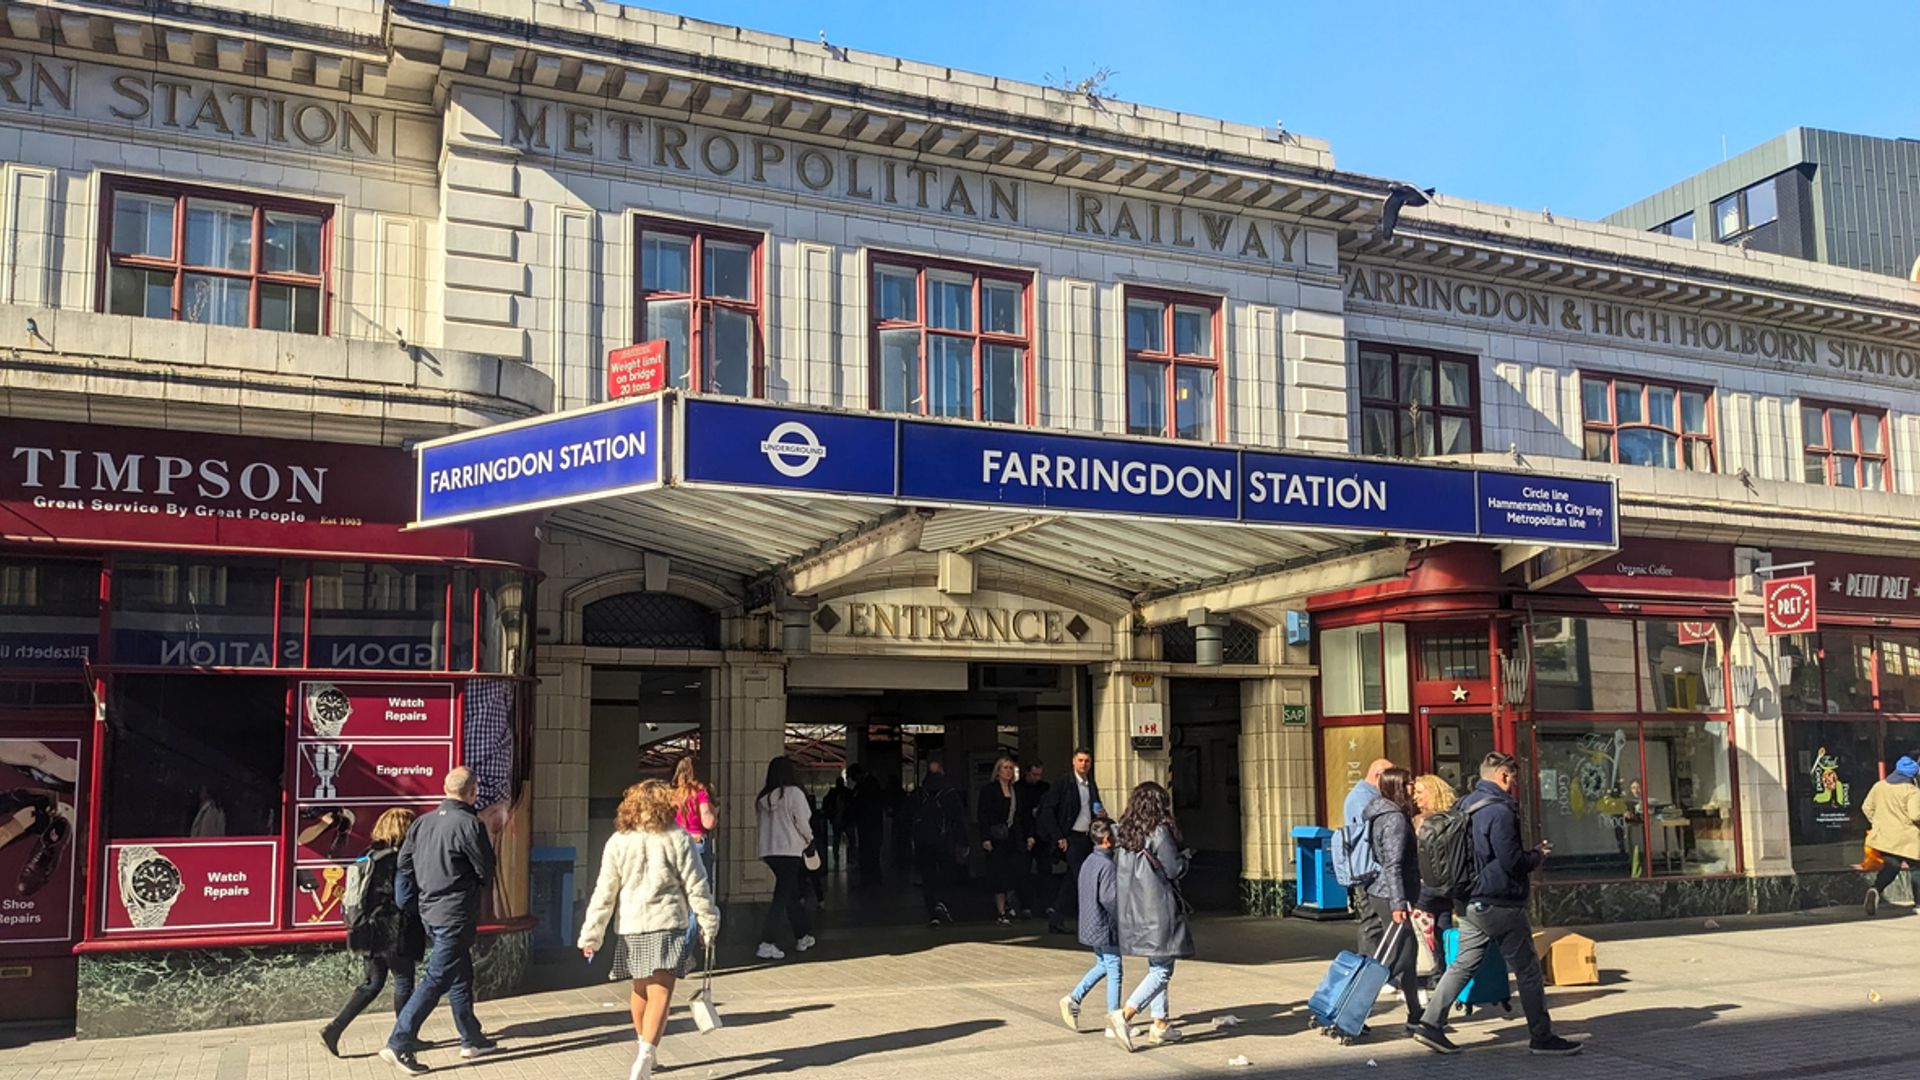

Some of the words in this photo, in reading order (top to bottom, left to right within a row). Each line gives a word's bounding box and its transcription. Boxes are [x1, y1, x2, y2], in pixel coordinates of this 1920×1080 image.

[109, 73, 382, 157] STATION
[509, 98, 1020, 223] METROPOLITAN
[1075, 191, 1302, 263] RAILWAY
[1560, 301, 1584, 331] &
[1592, 303, 1671, 344] HIGH
[1678, 314, 1818, 364] HOLBORN
[611, 358, 640, 374] Weight
[642, 353, 662, 367] limit
[616, 375, 627, 384] on
[629, 368, 656, 382] bridge
[620, 383, 631, 396] 20
[632, 381, 651, 393] tons
[763, 443, 824, 455] UNDERGROUND
[429, 446, 553, 494] FARRINGDON
[559, 430, 647, 471] STATION
[12, 446, 329, 504] TIMPSON
[982, 449, 1232, 501] FARRINGDON
[1248, 471, 1388, 511] STATION
[1522, 486, 1550, 500] Circle
[1551, 489, 1569, 501] line
[34, 495, 85, 510] Great
[91, 499, 159, 514] Service
[166, 503, 188, 518] By
[195, 505, 242, 519] Great
[249, 508, 306, 524] People
[1488, 497, 1553, 513] Hammersmith
[1555, 503, 1562, 513] &
[1564, 503, 1584, 517] City
[1586, 505, 1603, 517] line
[320, 516, 337, 525] Est
[1507, 511, 1567, 527] Metropolitan
[1569, 518, 1586, 528] line
[1616, 562, 1648, 576] Organic
[1648, 564, 1673, 577] Coffee
[1846, 573, 1880, 598] PETIT
[1880, 576, 1911, 601] PRET
[1777, 596, 1802, 616] PRET
[848, 601, 1064, 644] ENTRANCE
[388, 697, 425, 709] Watch
[385, 710, 427, 723] Repairs
[1284, 709, 1305, 721] SAP
[376, 764, 434, 778] Engraving
[207, 871, 247, 884] Watch
[204, 884, 250, 900] Repairs
[2, 899, 35, 911] Shoe
